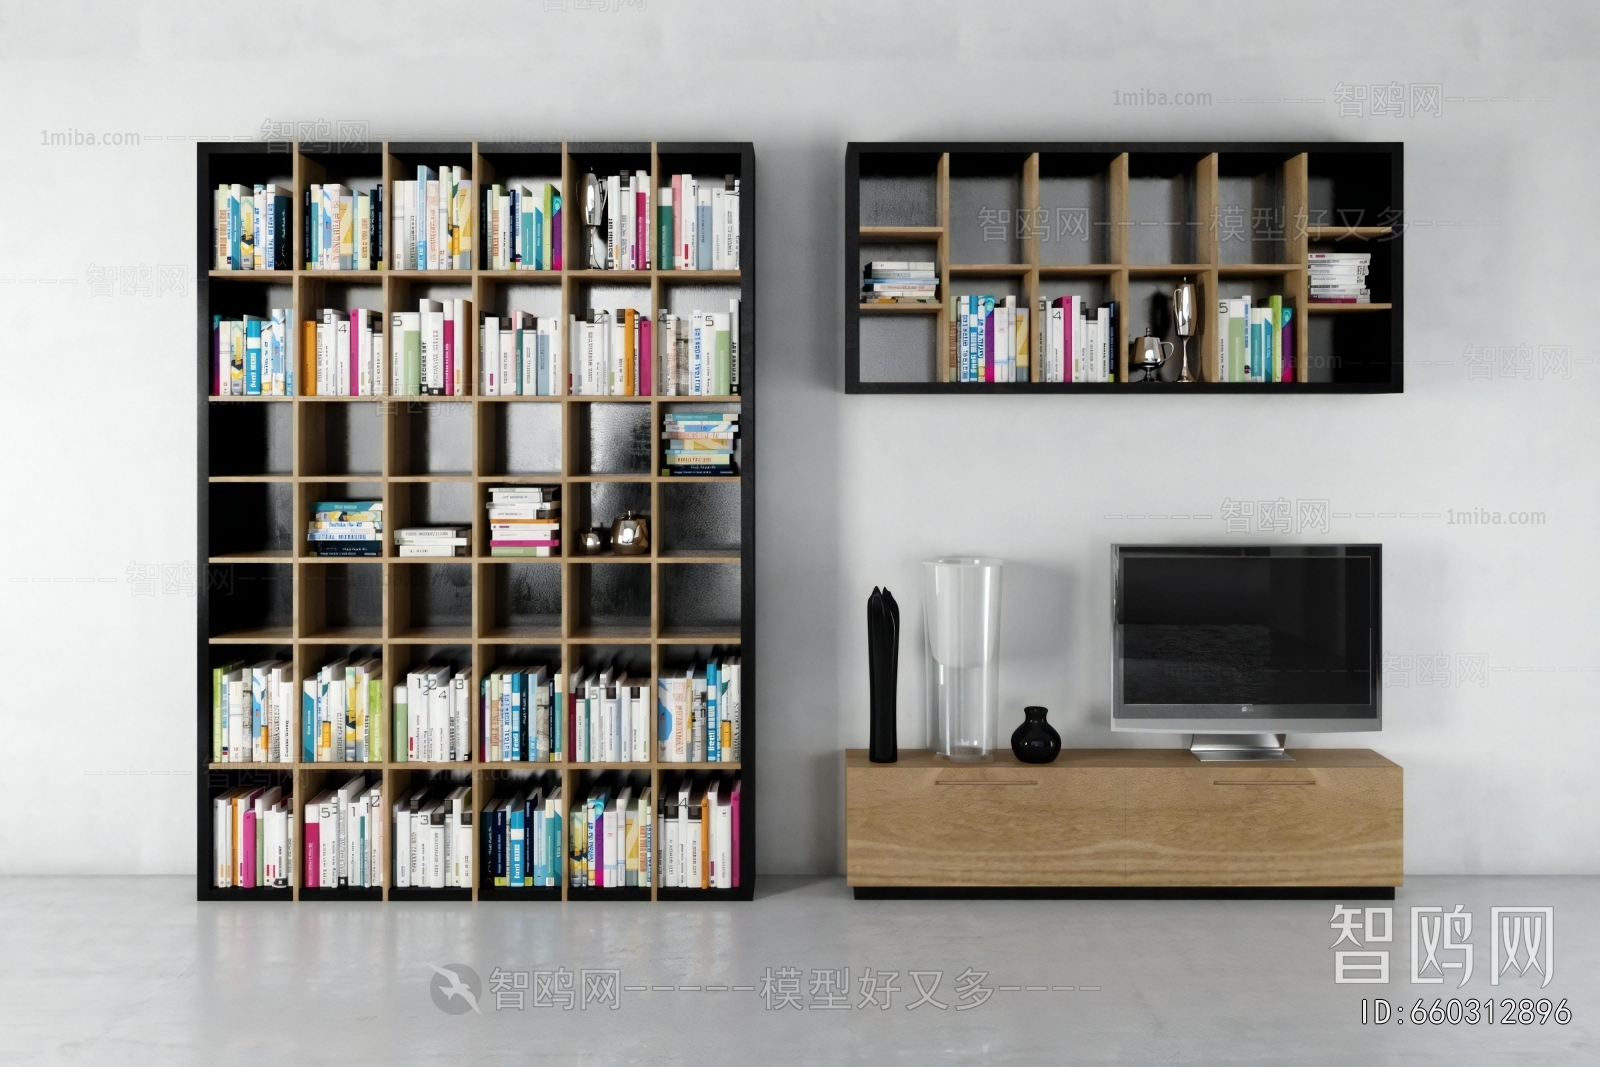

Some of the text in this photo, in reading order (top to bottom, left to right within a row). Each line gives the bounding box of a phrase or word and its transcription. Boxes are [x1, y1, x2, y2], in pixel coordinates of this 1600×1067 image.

[1218, 302, 1228, 314] 5
[392, 315, 402, 326] 5
[704, 315, 714, 327] 5
[1052, 311, 1062, 321] 4
[338, 324, 347, 333] 4
[417, 678, 422, 689] 1
[321, 807, 331, 819] 5
